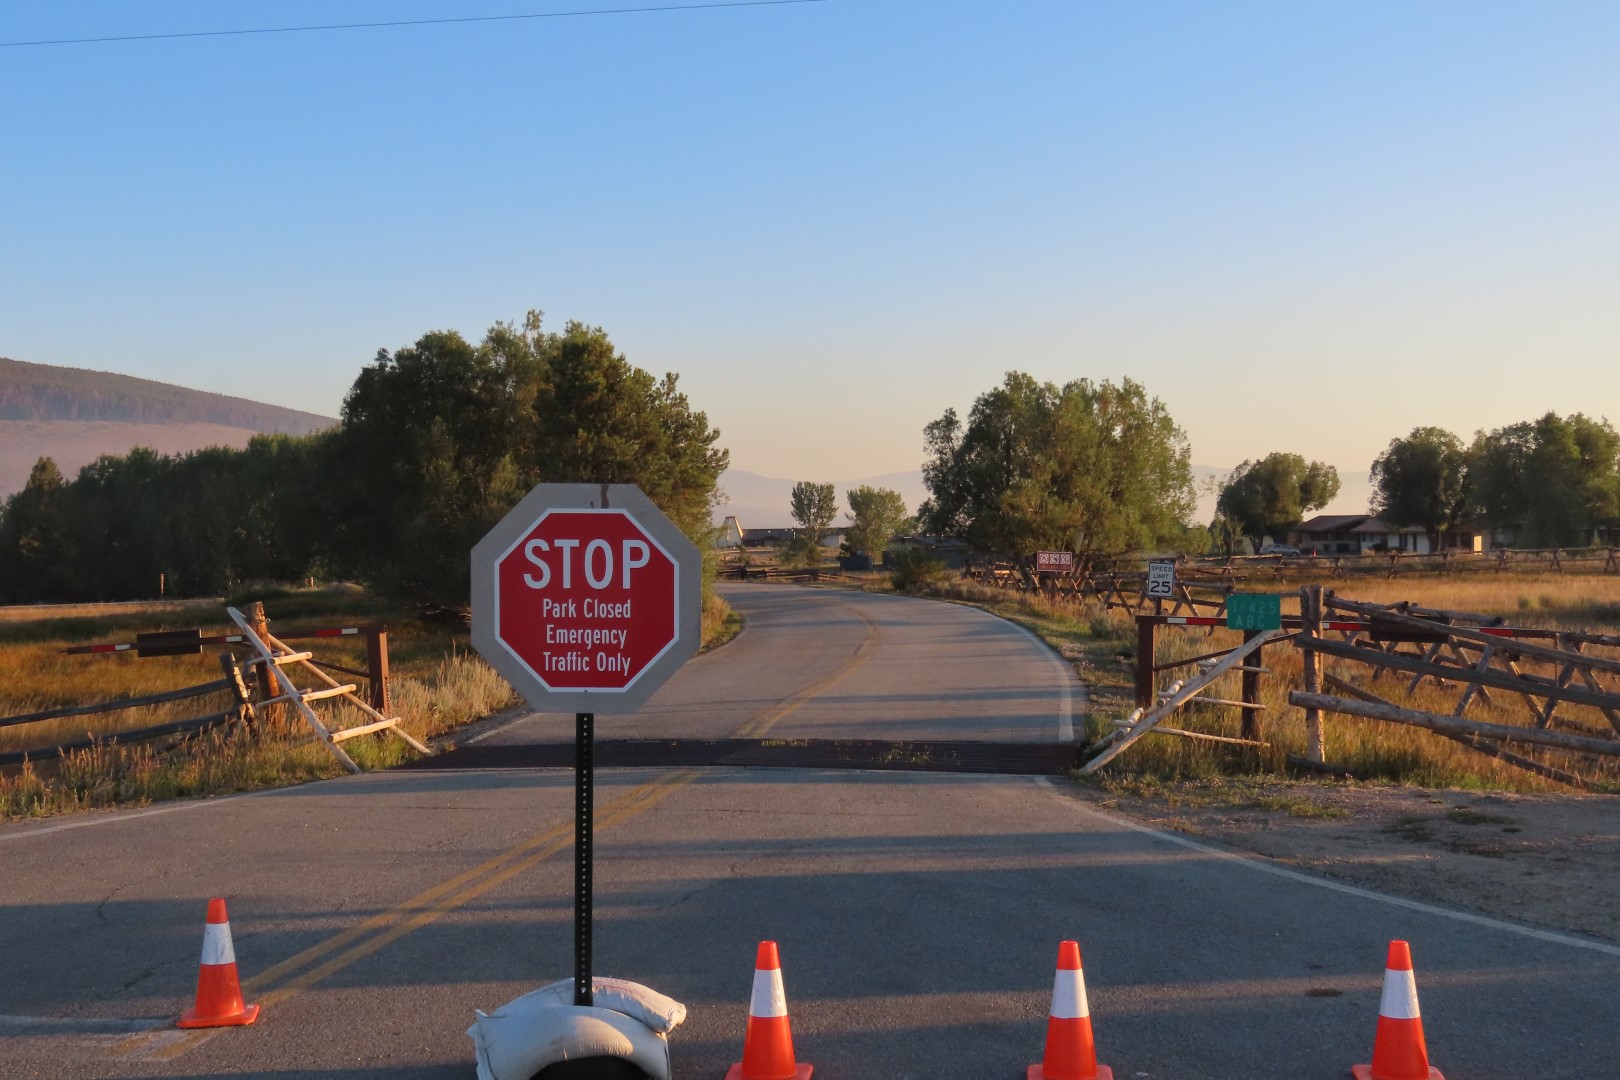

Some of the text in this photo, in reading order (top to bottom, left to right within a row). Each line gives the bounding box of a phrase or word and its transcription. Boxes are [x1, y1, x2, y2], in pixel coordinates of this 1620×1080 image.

[523, 538, 651, 590] STOP
[1150, 580, 1171, 593] 25
[543, 598, 631, 618] Park Closed
[1232, 600, 1276, 614] 16425
[546, 624, 627, 649] Emergency
[543, 652, 631, 676] Traffic Only
